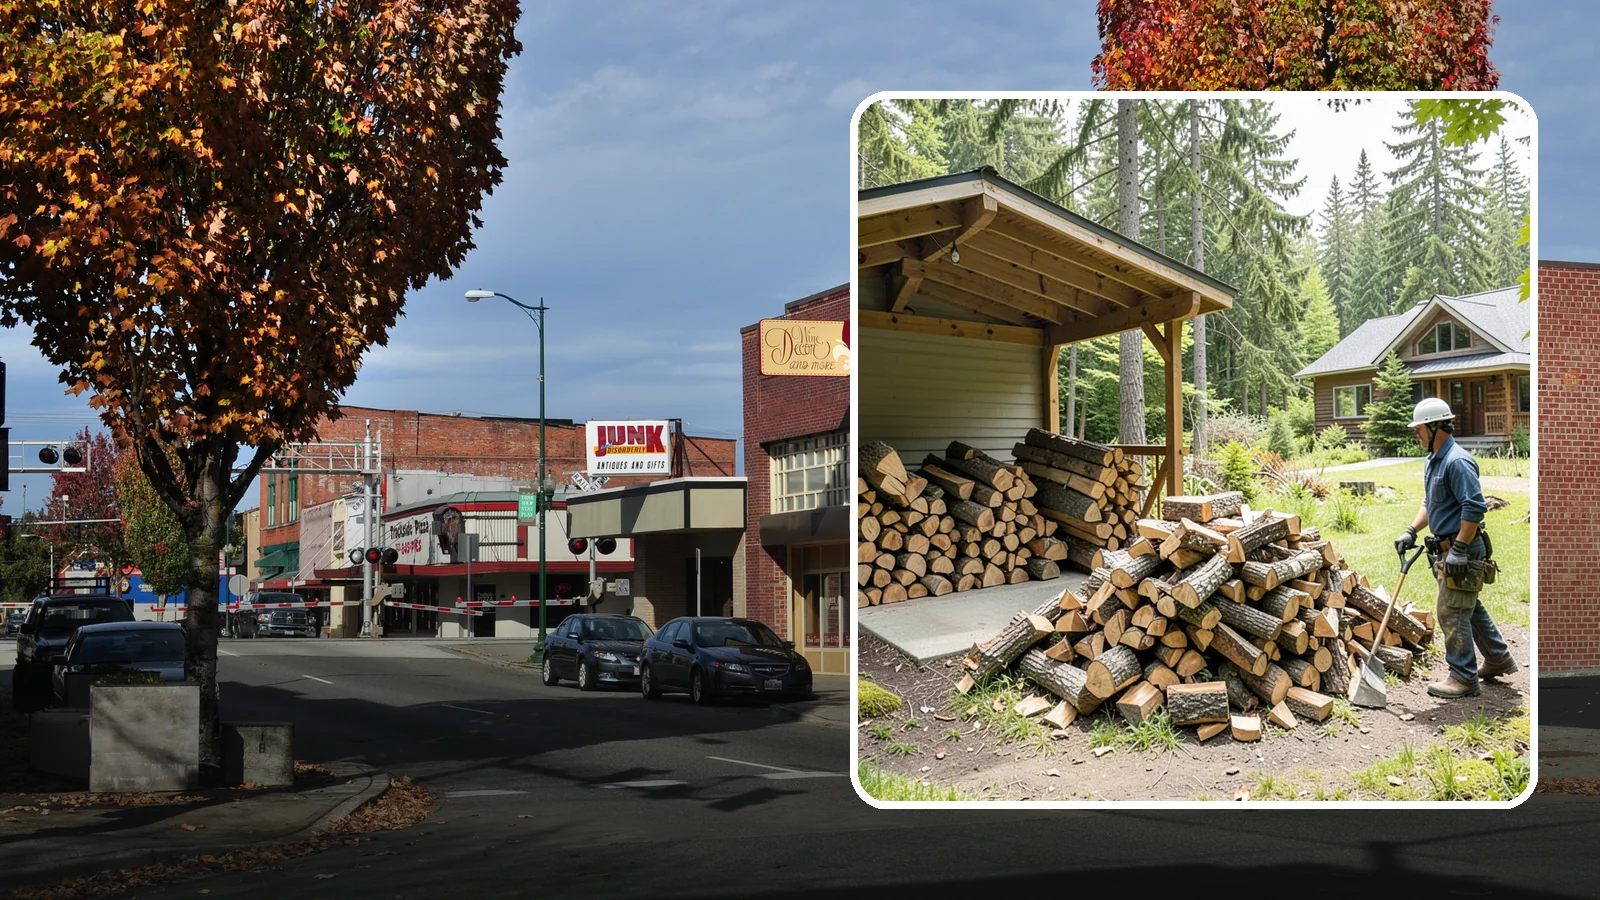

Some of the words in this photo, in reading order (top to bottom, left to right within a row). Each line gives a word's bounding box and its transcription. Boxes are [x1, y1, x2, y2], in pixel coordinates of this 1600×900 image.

[596, 425, 665, 457] JUNK
[607, 446, 645, 454] DISORDERLY
[597, 461, 628, 470] ANTIQUES
[631, 461, 643, 470] AND
[647, 460, 665, 470] GIFTS
[573, 473, 589, 490] RAIL
[352, 498, 364, 511] CRO
[414, 519, 429, 535] Pizza
